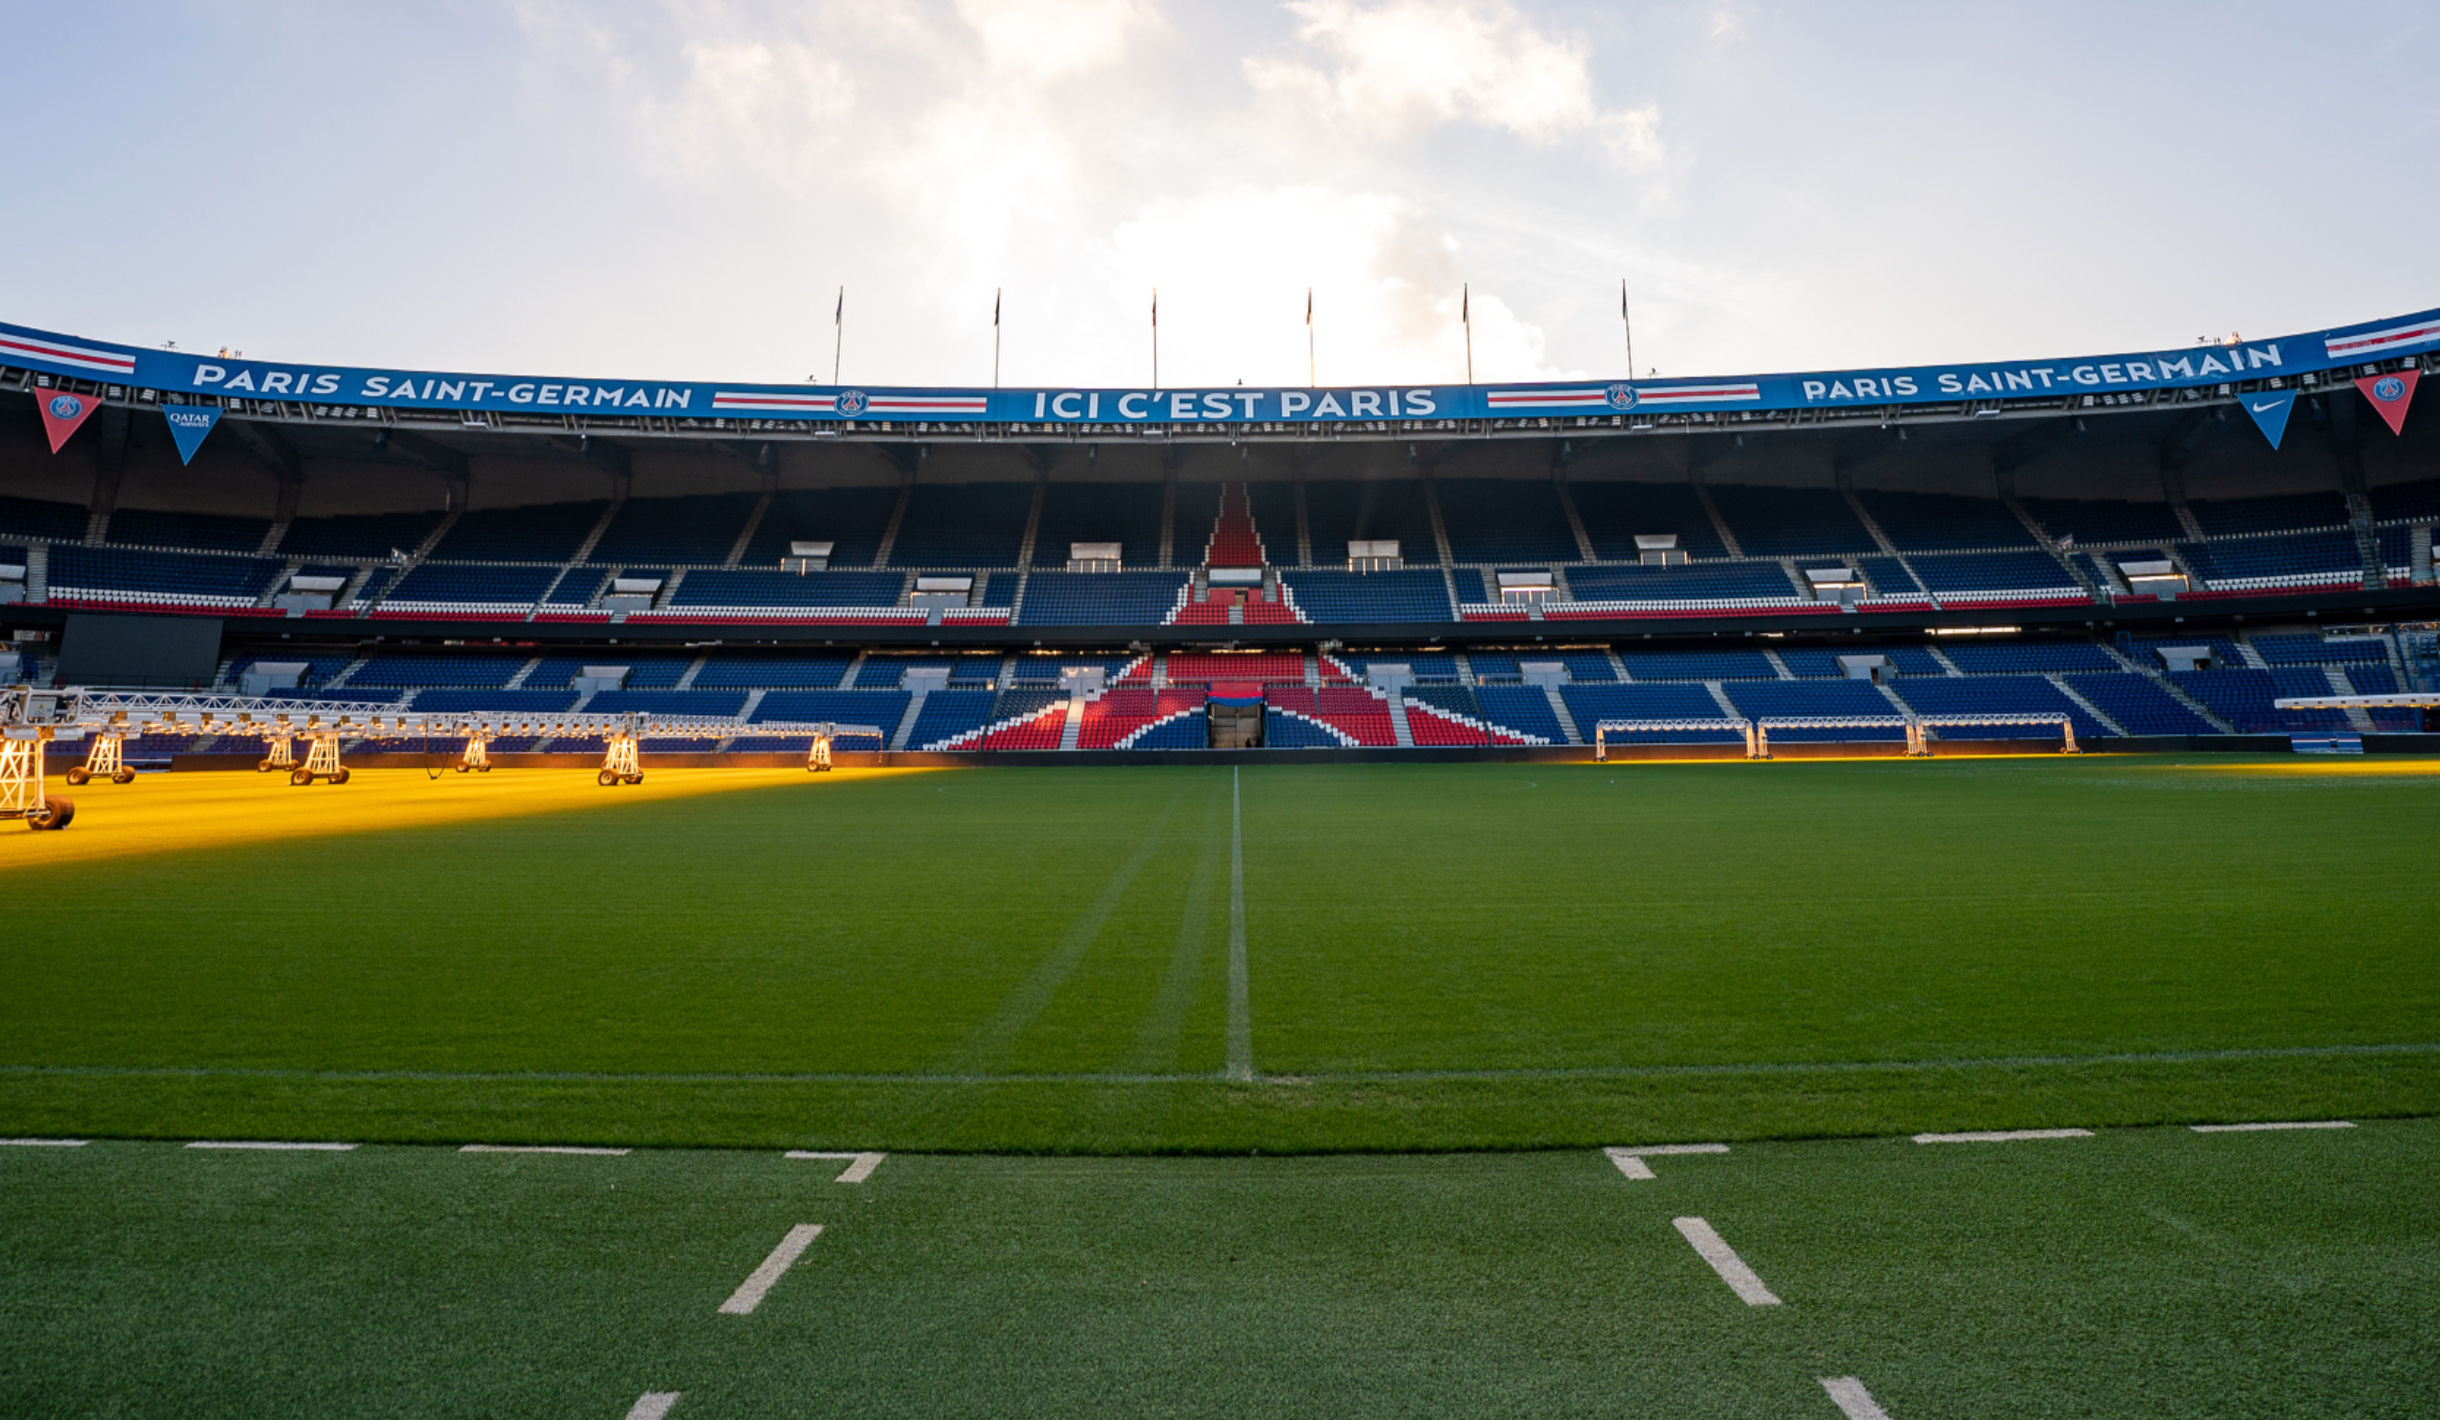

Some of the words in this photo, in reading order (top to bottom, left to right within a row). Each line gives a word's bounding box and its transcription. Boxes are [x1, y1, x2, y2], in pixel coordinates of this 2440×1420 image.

[193, 364, 341, 394] PARIS
[361, 376, 691, 408] SAINT-GERMAIN
[1803, 376, 1918, 400] PARIS
[1938, 344, 2283, 393] SAINT-GERMAIN
[169, 412, 210, 423] QATAR
[1034, 392, 1099, 419] ICI
[1118, 391, 1264, 419] C'EST
[1280, 389, 1436, 418] PARIS
